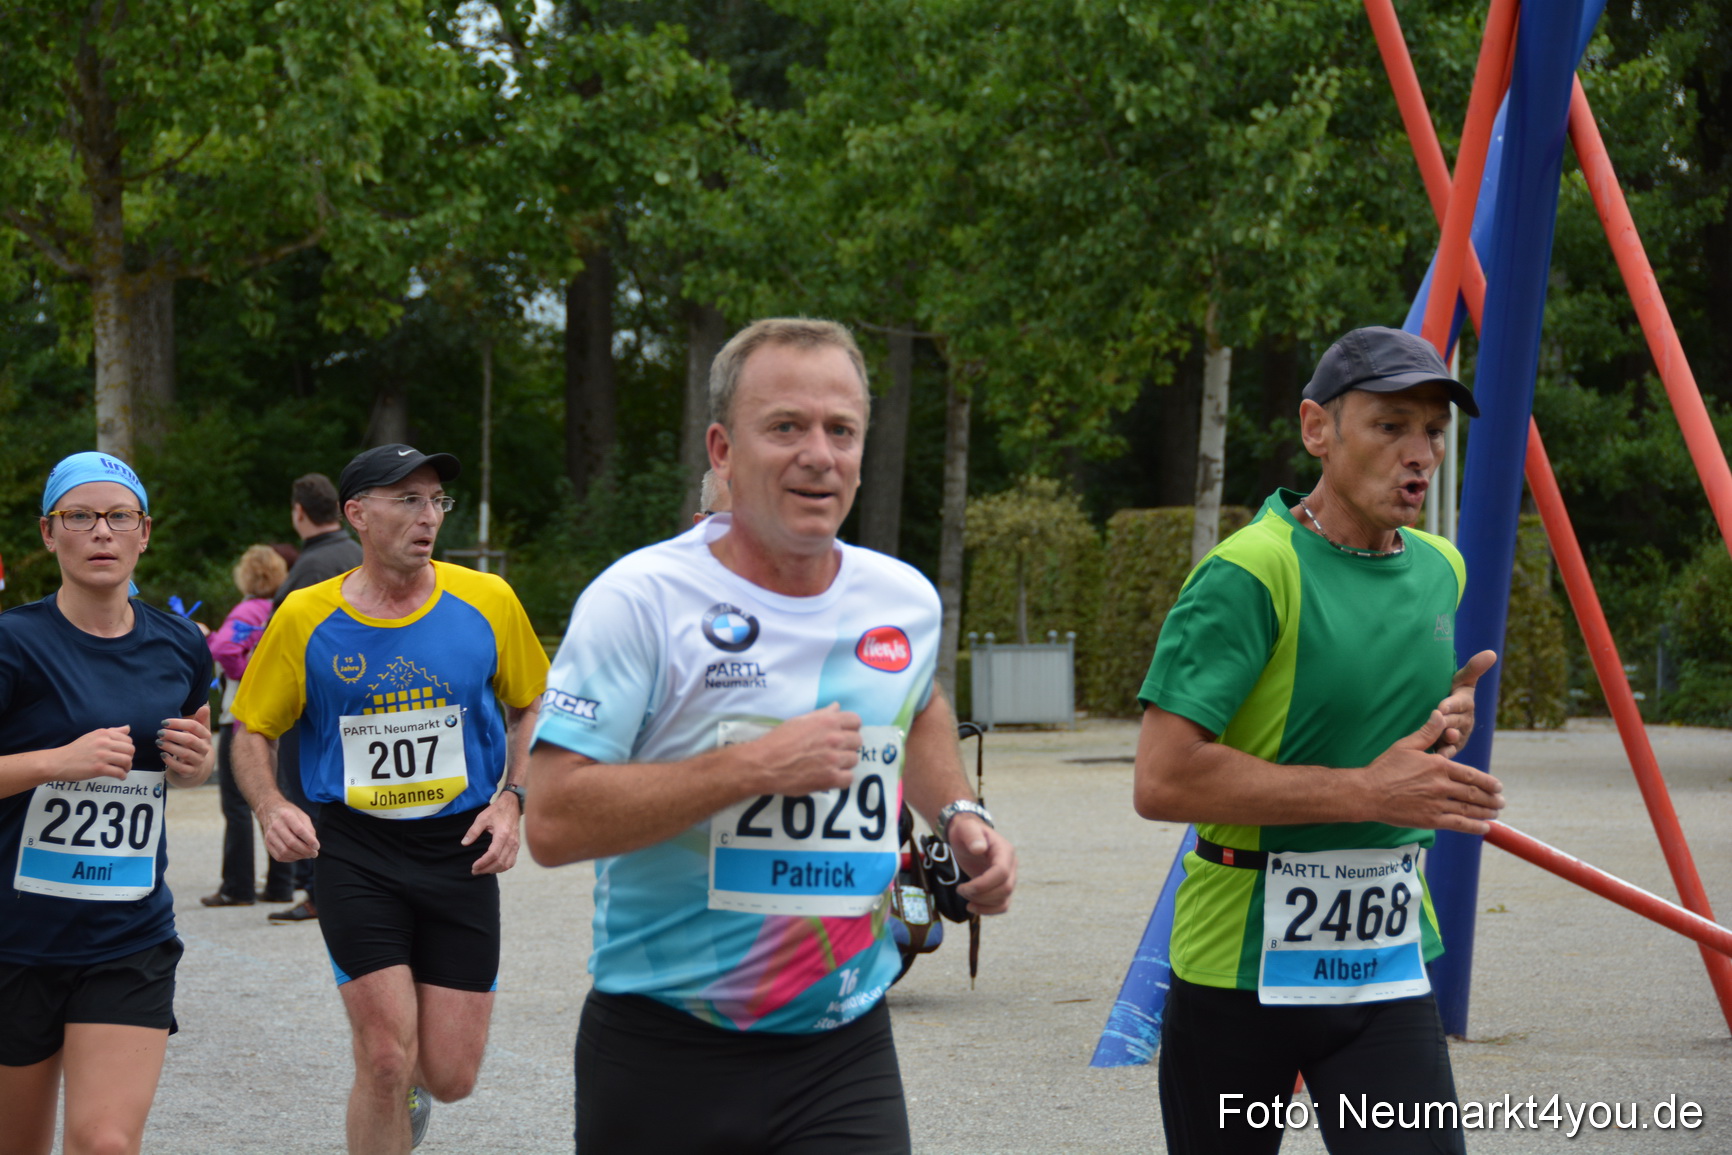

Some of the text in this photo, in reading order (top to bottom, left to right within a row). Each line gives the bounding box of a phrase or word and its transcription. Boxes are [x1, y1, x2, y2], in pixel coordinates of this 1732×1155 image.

[705, 662, 767, 677] PARTL
[705, 677, 767, 689] Neumarkt
[343, 719, 441, 737] PARTL Neumarkt
[368, 735, 440, 780] 207
[45, 781, 149, 796] ARTL Neumarkt
[370, 787, 445, 807] Johannes
[735, 773, 887, 842] 2629
[39, 797, 154, 850] 2230
[28, 838, 34, 846] B
[720, 832, 729, 845] C
[71, 861, 113, 881] Anni
[771, 860, 856, 888] Patrick
[1335, 863, 1400, 879] Neumarkt
[1283, 881, 1412, 943] 2468
[1270, 938, 1278, 950] B
[1313, 957, 1379, 981] Albert
